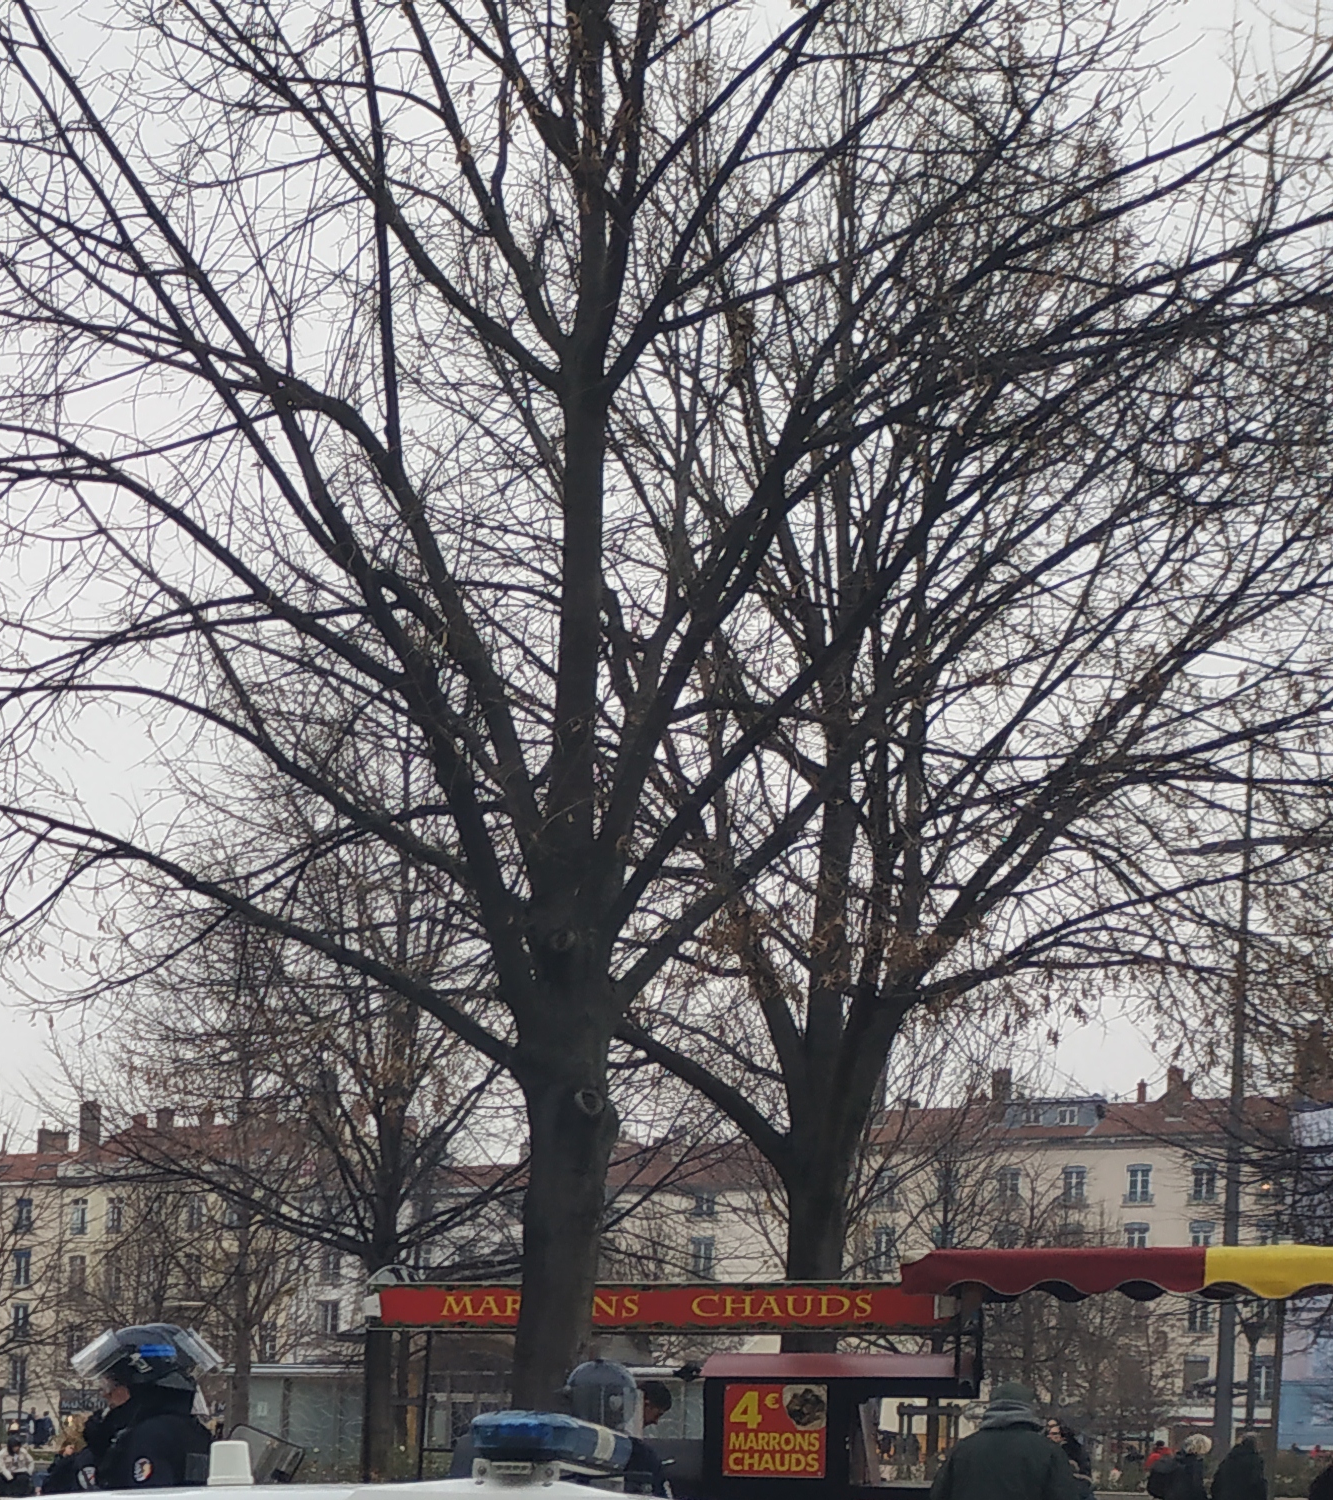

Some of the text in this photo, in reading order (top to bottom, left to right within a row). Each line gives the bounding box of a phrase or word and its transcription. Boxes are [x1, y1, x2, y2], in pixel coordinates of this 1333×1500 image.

[440, 1293, 873, 1319] MARNS CHAUDS
[728, 1431, 820, 1452] MARRONS
[728, 1452, 820, 1472] CHAUDS
